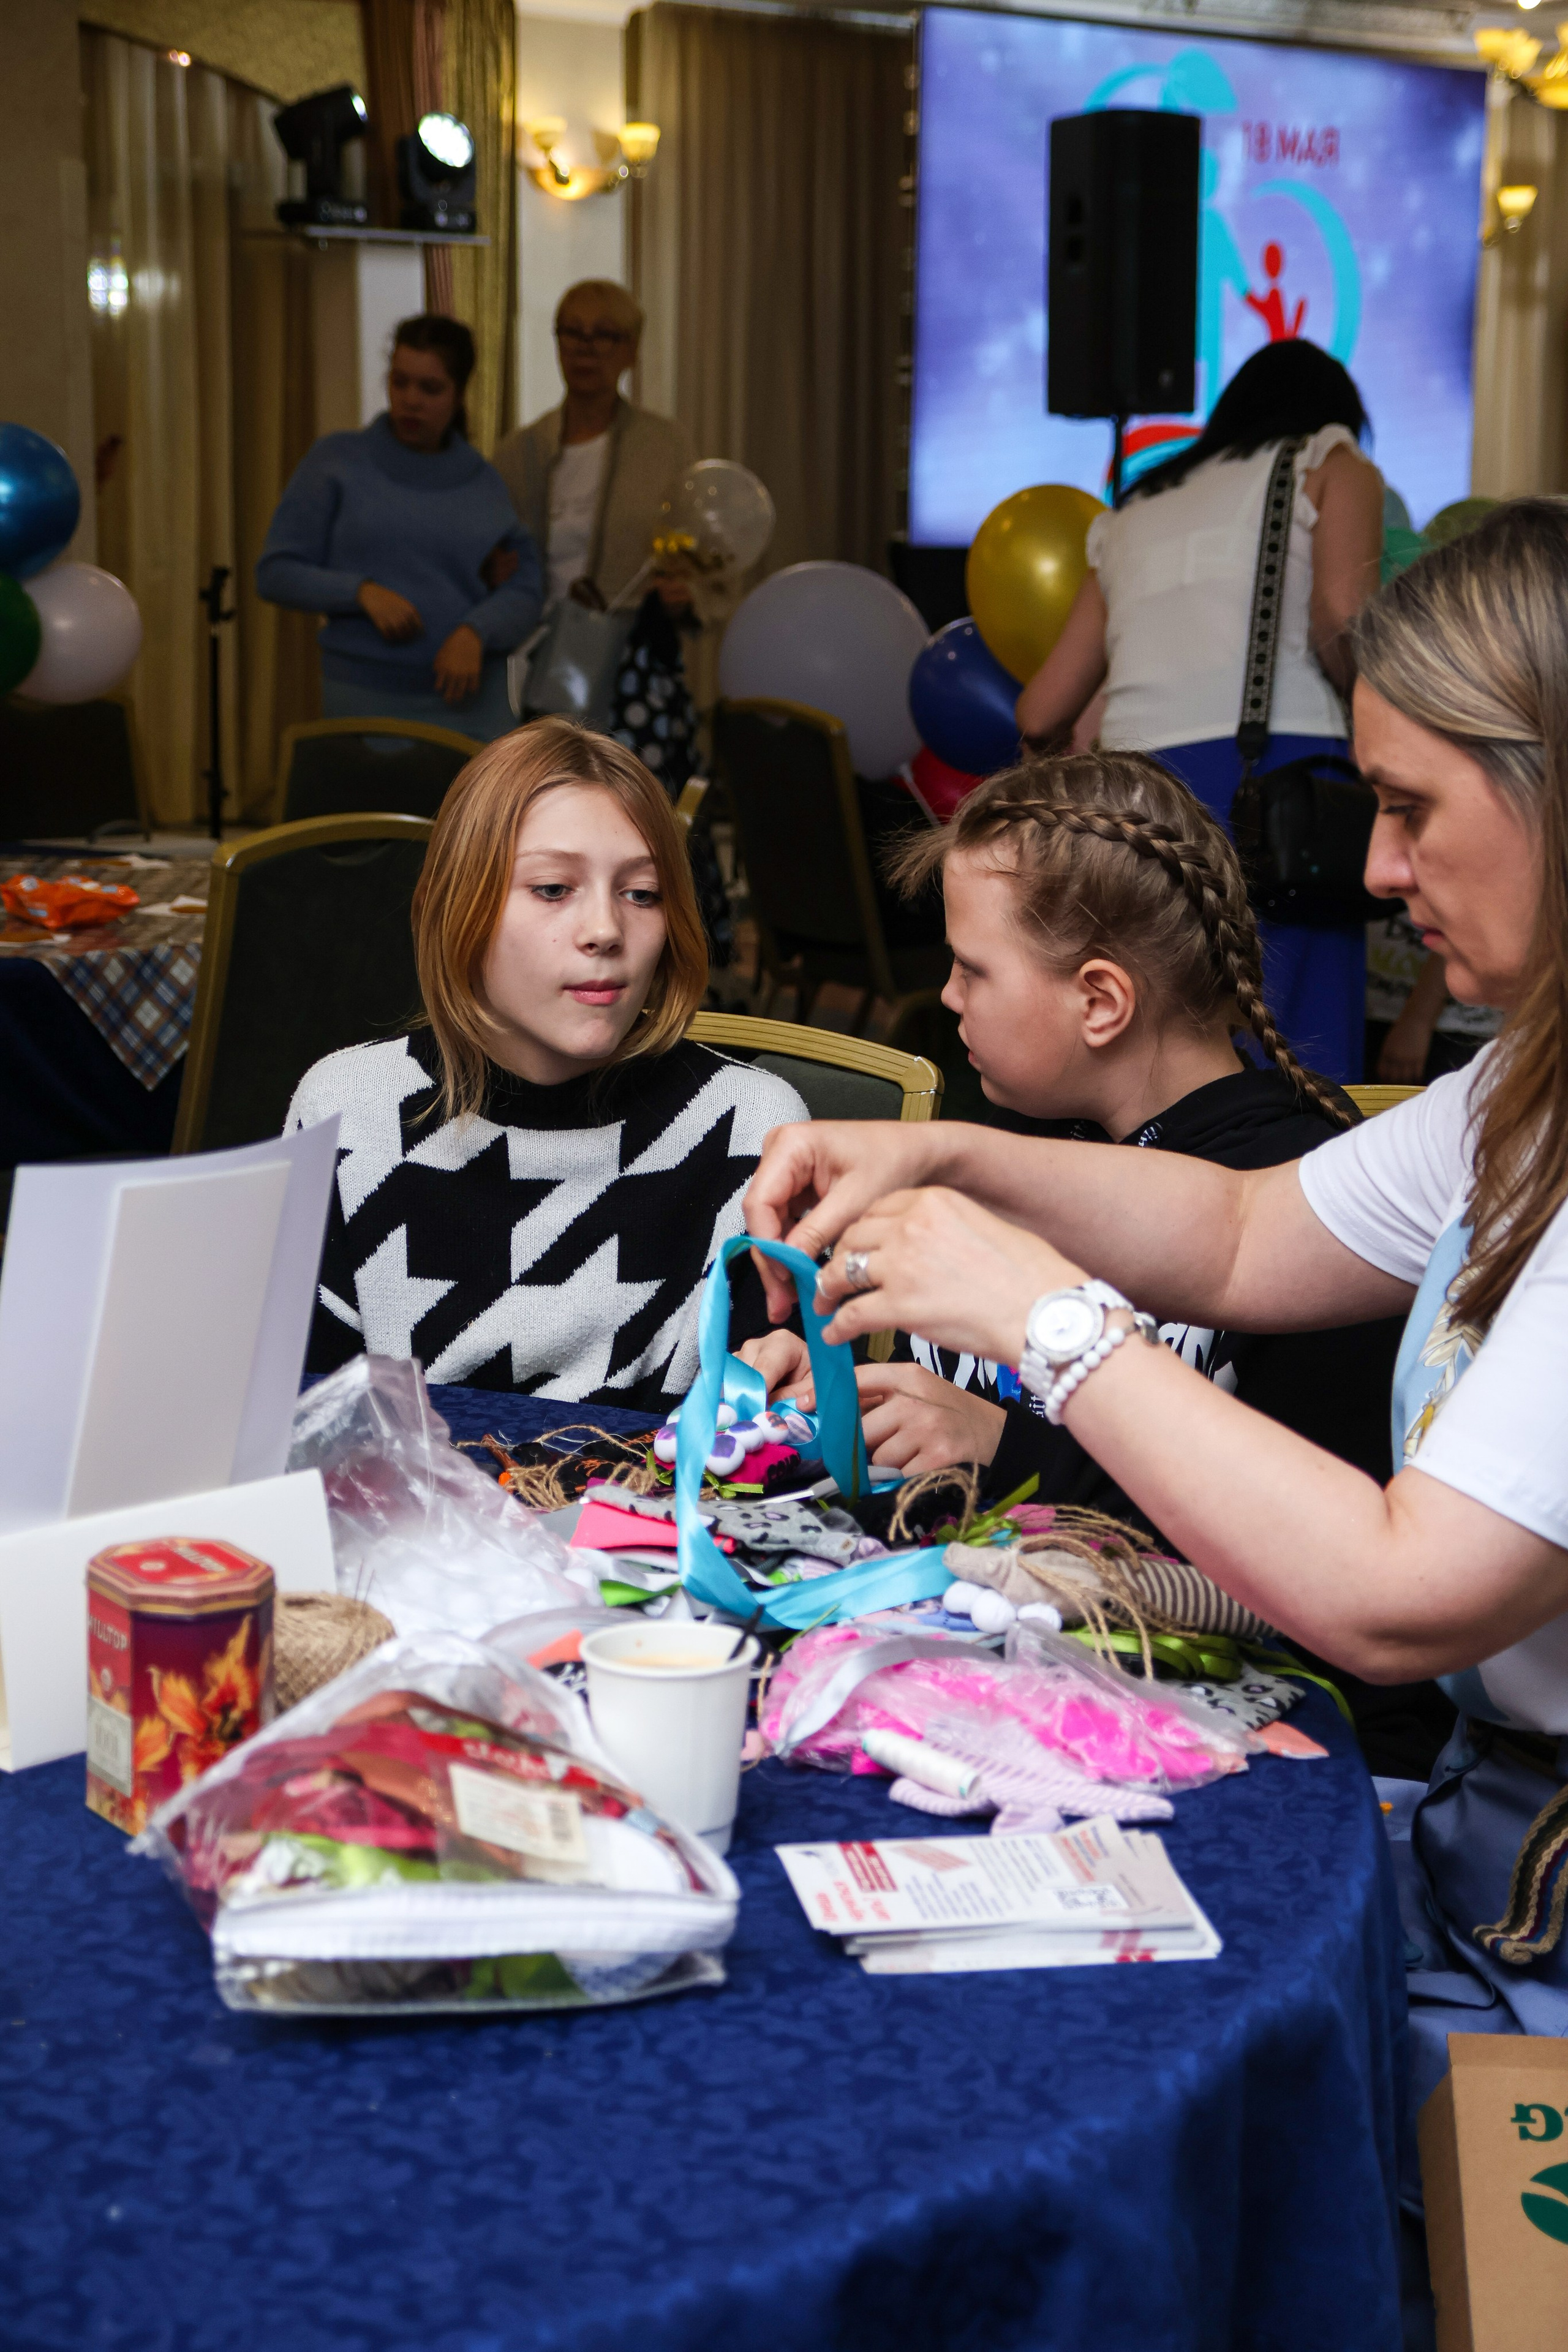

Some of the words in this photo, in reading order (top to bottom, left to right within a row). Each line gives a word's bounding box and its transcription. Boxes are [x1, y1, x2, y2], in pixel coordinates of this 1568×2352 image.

[1242, 121, 1270, 164] 18
[1276, 124, 1340, 168] МАЯ
[1510, 2103, 1568, 2143] G
